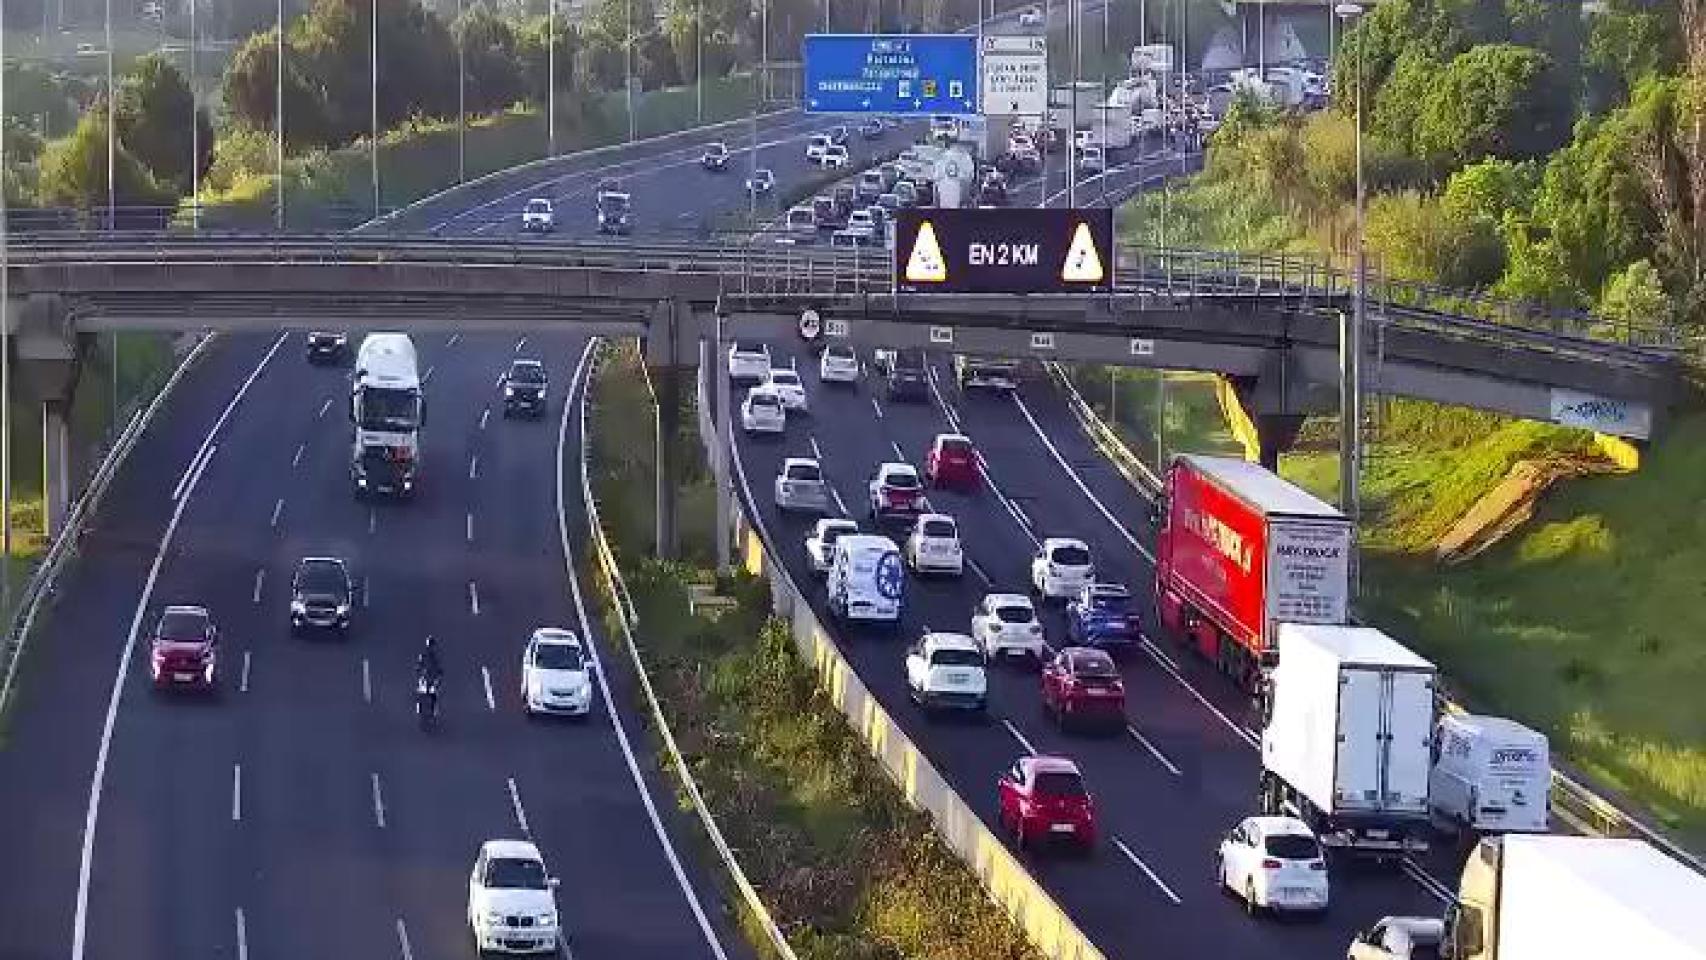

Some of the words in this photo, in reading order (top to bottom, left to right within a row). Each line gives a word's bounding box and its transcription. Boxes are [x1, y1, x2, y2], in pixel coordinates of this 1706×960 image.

[969, 244, 994, 265] EN
[998, 244, 1009, 265] 2
[1012, 244, 1038, 265] KM
